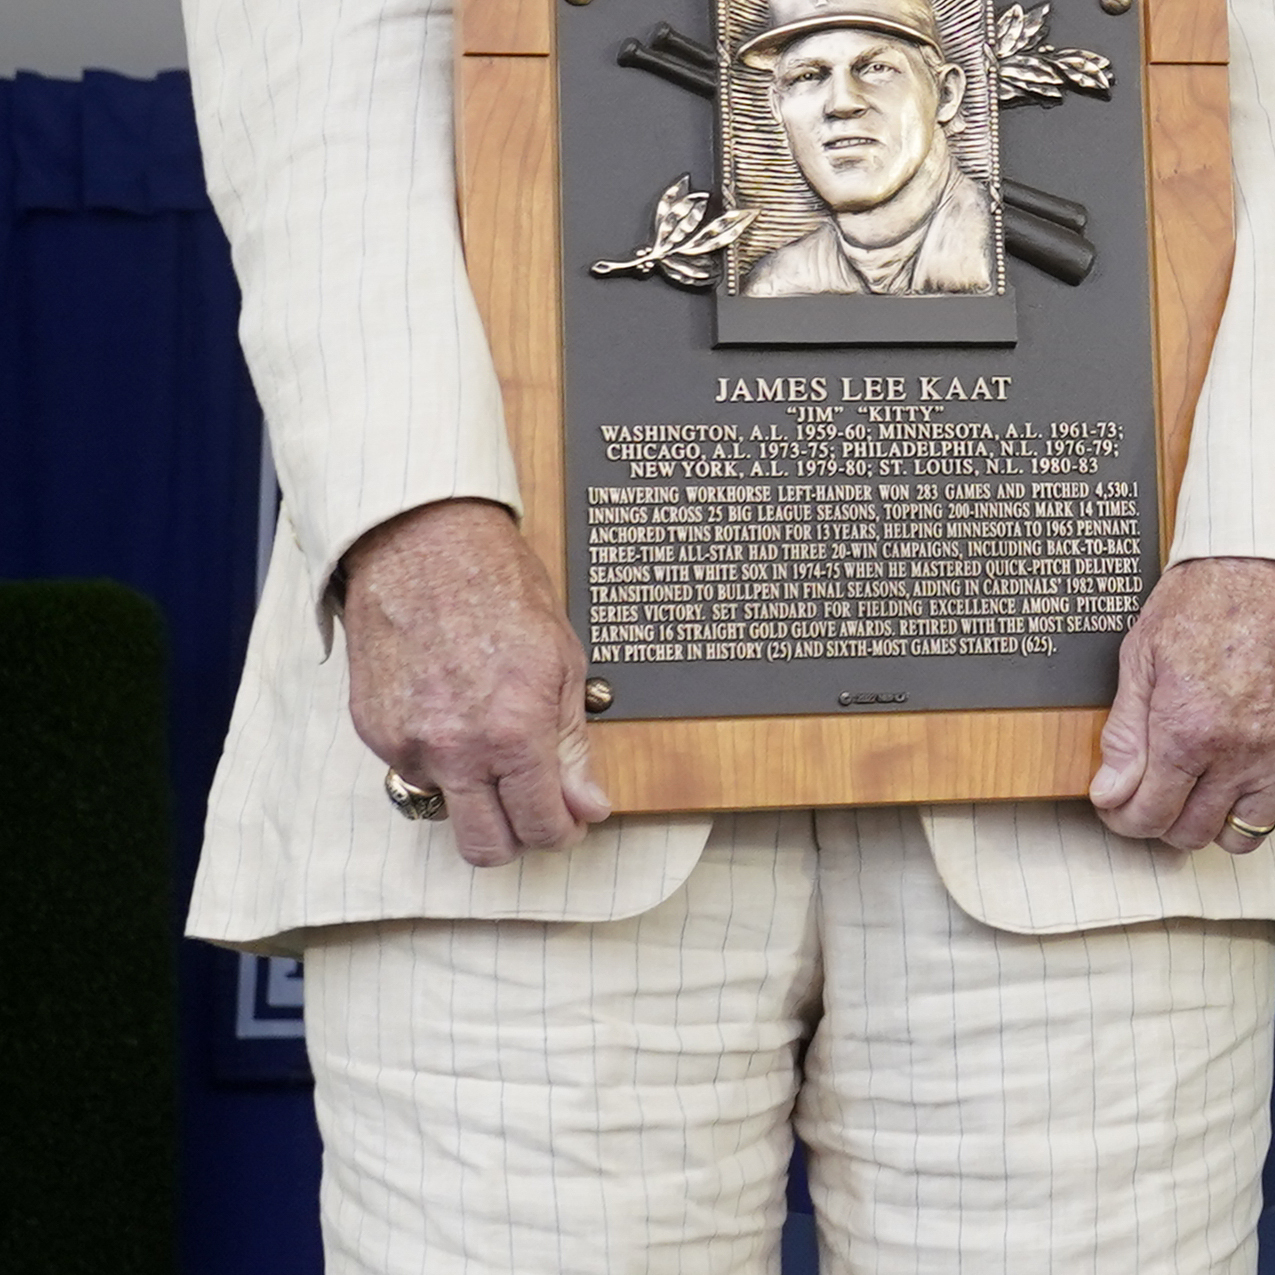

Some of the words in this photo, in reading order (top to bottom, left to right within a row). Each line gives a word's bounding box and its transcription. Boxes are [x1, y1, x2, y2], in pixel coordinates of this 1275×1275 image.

[715, 377, 827, 401] JAMES
[841, 377, 906, 400] LEE
[919, 376, 1011, 400] KAAT
[600, 423, 744, 444] WASHINGTON,
[749, 424, 788, 440] A.L.
[796, 423, 872, 443] 1959-60;
[878, 422, 999, 441] MINNESOTA,
[1005, 422, 1042, 438] A.L.
[1050, 421, 1123, 440] 1961-73;
[606, 442, 706, 463] CHICAGO,
[712, 442, 751, 459] A.L.
[759, 441, 835, 462] 1973-75;
[842, 438, 994, 459] PHILADELPHIA,
[1000, 440, 1038, 456] N.L.
[1046, 439, 1119, 458] 1976-79;
[630, 461, 676, 478] NEW
[681, 458, 744, 479] YORK,
[750, 460, 788, 476] A.L.
[797, 457, 873, 478] 1979-80;
[879, 459, 907, 475] ST.
[914, 458, 979, 477] LOUIS,
[985, 458, 1024, 474] N.L.
[1031, 456, 1098, 474] 1980-83
[588, 485, 679, 504] UNWAVERING
[685, 485, 771, 503] WORKHORSE
[777, 484, 872, 501] LEFT-HANDER
[878, 483, 909, 500] WON
[916, 483, 938, 500] 283
[945, 483, 991, 500] GAMES
[997, 482, 1025, 499] AND
[1031, 481, 1089, 498] PITCHED
[1095, 481, 1137, 499] 4,530.1
[588, 506, 648, 524] INNINGS
[651, 505, 703, 523] ACROSS
[708, 505, 722, 522] 25
[728, 505, 752, 522] BIG
[757, 504, 812, 522] LEAGUE
[816, 503, 880, 523] SEASONS,
[883, 502, 943, 520] TOPPING
[948, 501, 1030, 519] 200-INNINGS
[1034, 500, 1074, 517] MARK
[1079, 500, 1093, 517] 14
[1096, 500, 1139, 516] TIMES.
[589, 545, 675, 563] THREE-TIME
[678, 544, 743, 562] ALL-STAR
[748, 543, 778, 560] HAD
[781, 543, 827, 560] THREE
[831, 542, 877, 559] 20-WIN
[882, 540, 963, 560] CAMPAIGNS,
[968, 539, 1042, 557] INCLUDING
[1046, 537, 1141, 556] BACK-TO-BACK
